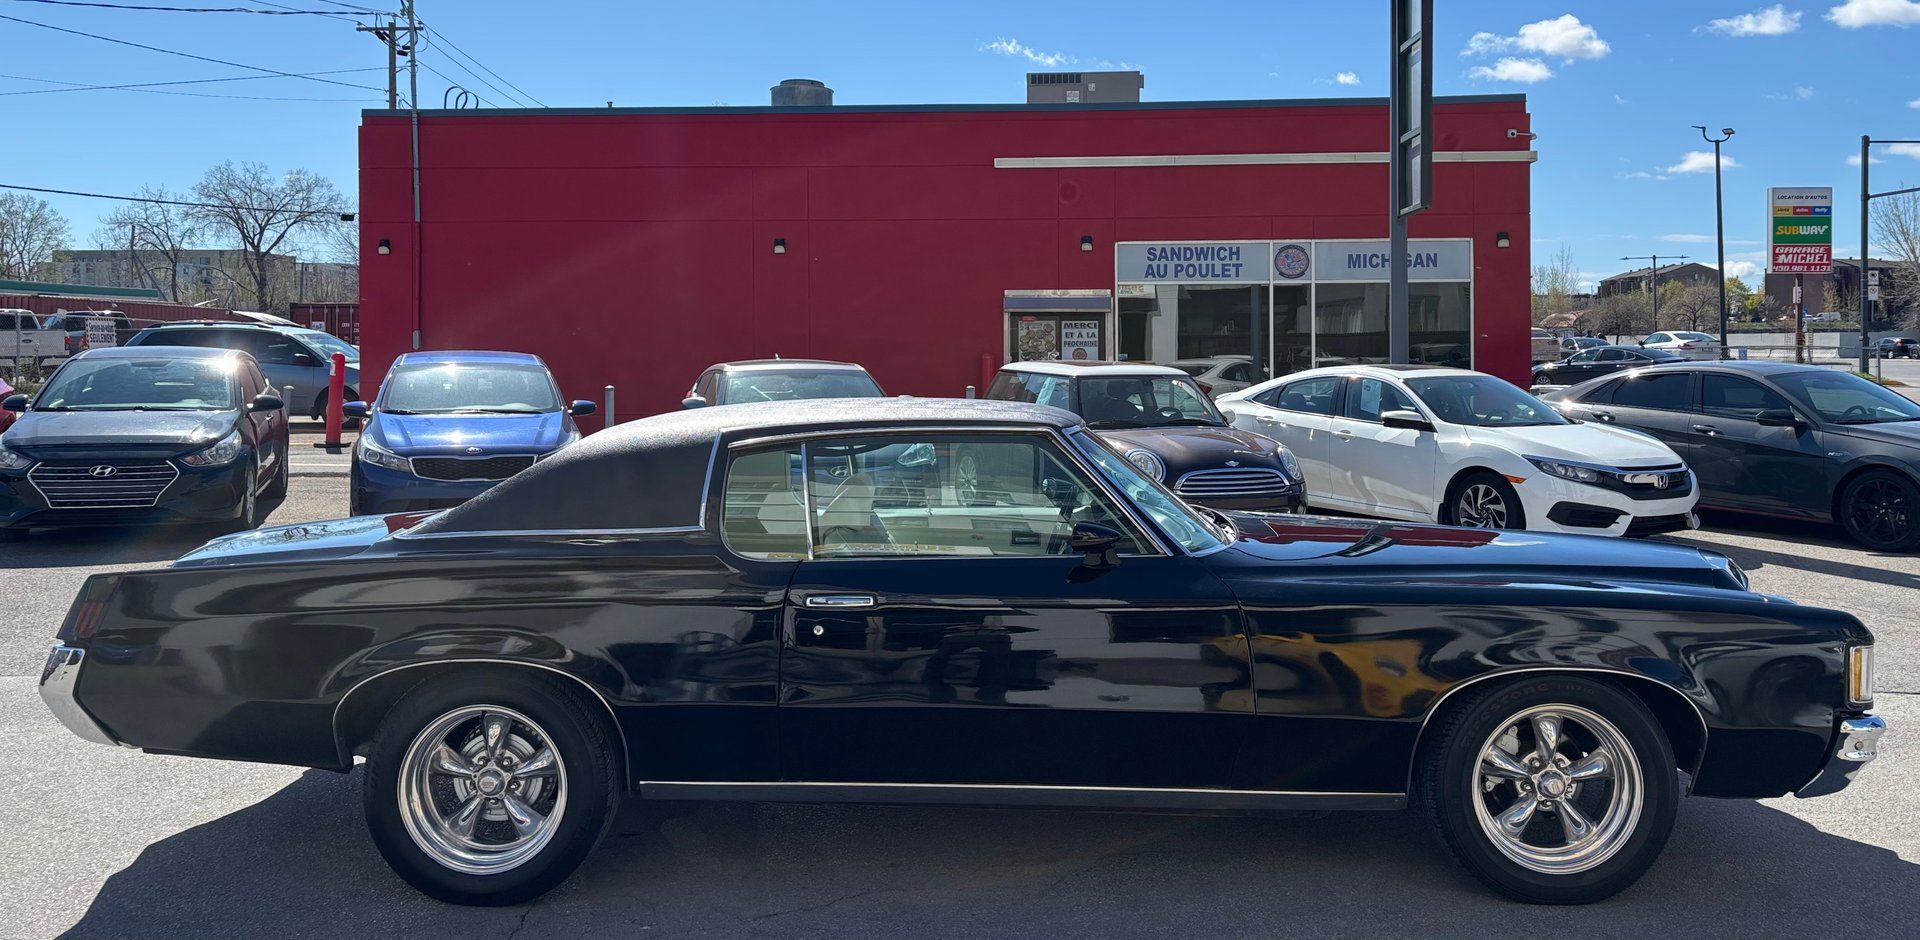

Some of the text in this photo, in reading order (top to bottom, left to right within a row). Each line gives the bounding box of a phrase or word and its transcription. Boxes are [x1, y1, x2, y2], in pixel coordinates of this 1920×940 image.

[1776, 225, 1829, 235] SUBWAY
[1146, 246, 1241, 262] SANDWICH
[1347, 252, 1438, 269] MICHAN
[1774, 253, 1830, 264] MICHEL
[1144, 262, 1243, 279] AU POULET
[1065, 331, 1075, 339] ET
[1087, 331, 1096, 339] LA
